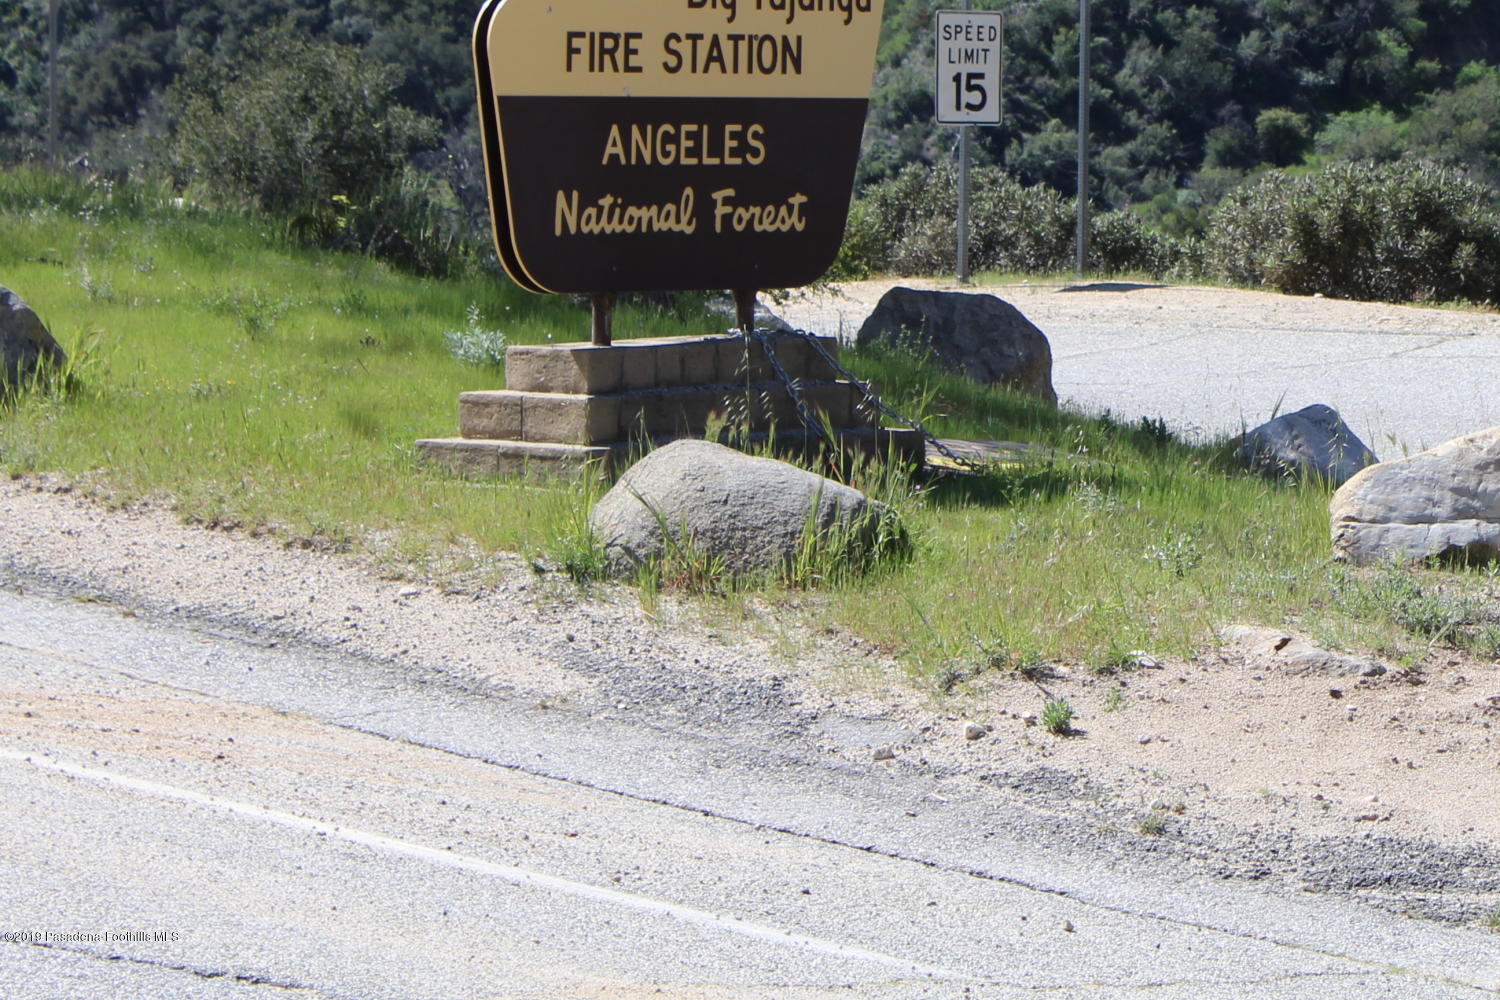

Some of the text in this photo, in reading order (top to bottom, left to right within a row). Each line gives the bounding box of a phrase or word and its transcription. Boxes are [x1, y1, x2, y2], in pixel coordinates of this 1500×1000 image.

[565, 31, 803, 75] FIRE STATION
[942, 24, 998, 42] SPEED
[948, 47, 991, 65] LIMIT
[952, 72, 988, 112] 15
[601, 123, 767, 167] ANGELES
[554, 186, 809, 238] National Forest
